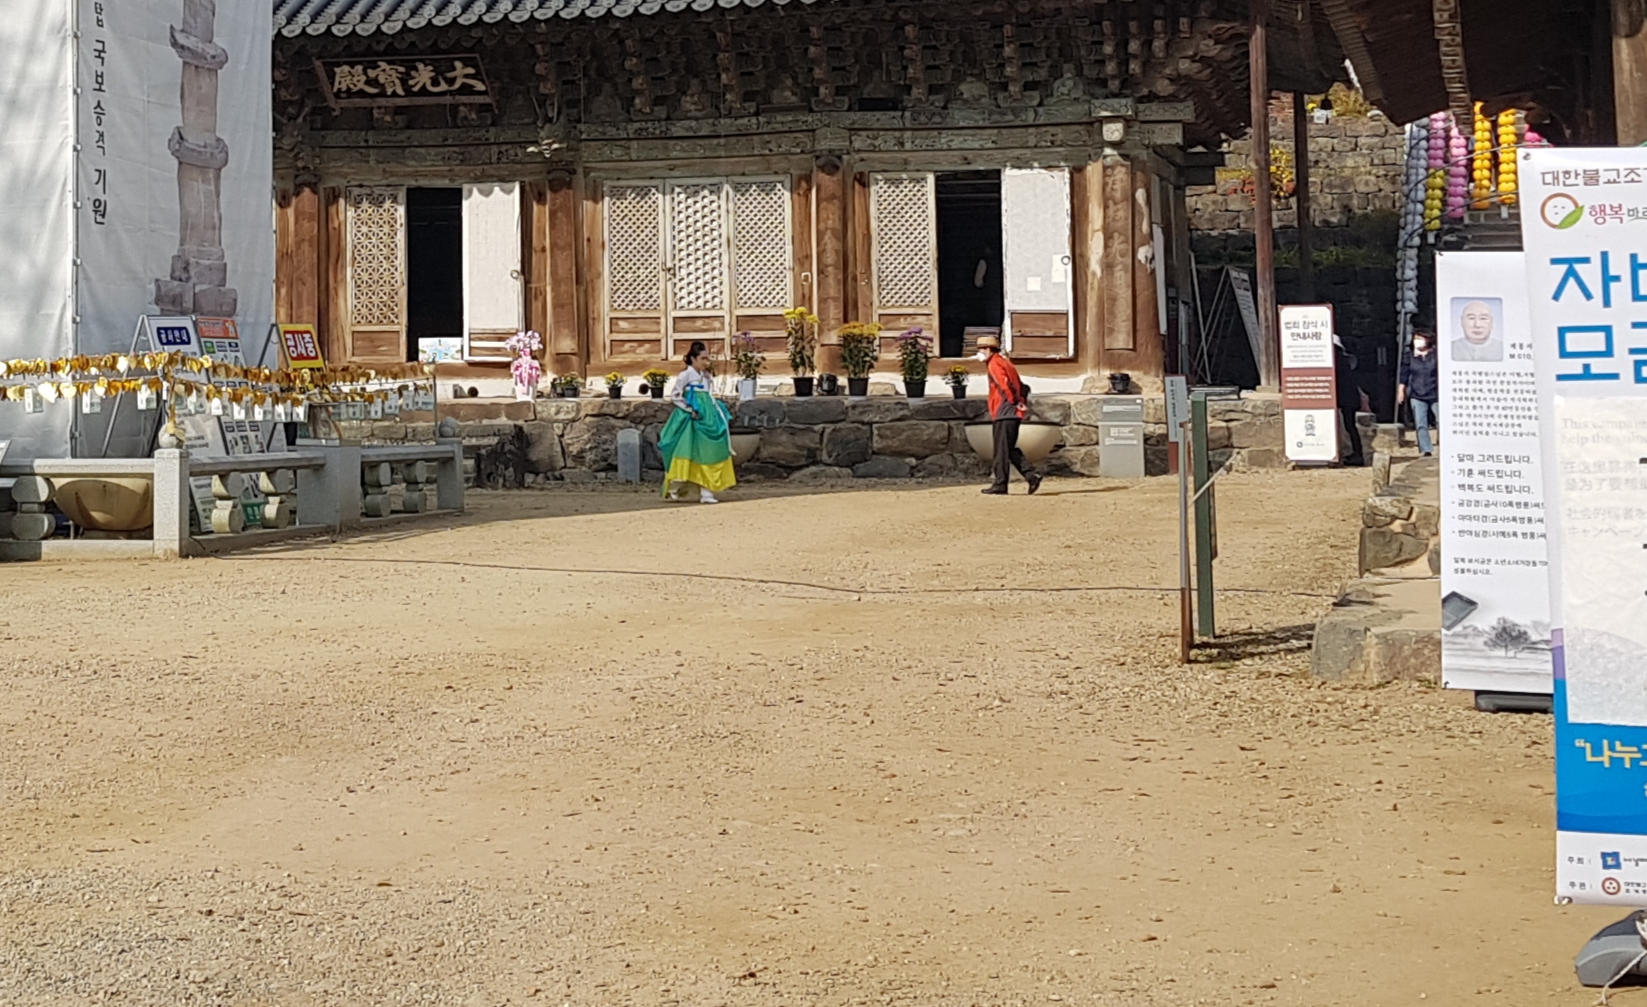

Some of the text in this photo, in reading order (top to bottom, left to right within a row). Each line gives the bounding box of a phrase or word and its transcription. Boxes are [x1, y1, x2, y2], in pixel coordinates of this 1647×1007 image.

[92, 39, 107, 157] 국보승격
[1540, 167, 1647, 187] 대한불교조
[91, 167, 107, 226] 기원
[285, 332, 317, 358] 공사중
[1457, 453, 1475, 463] 달마
